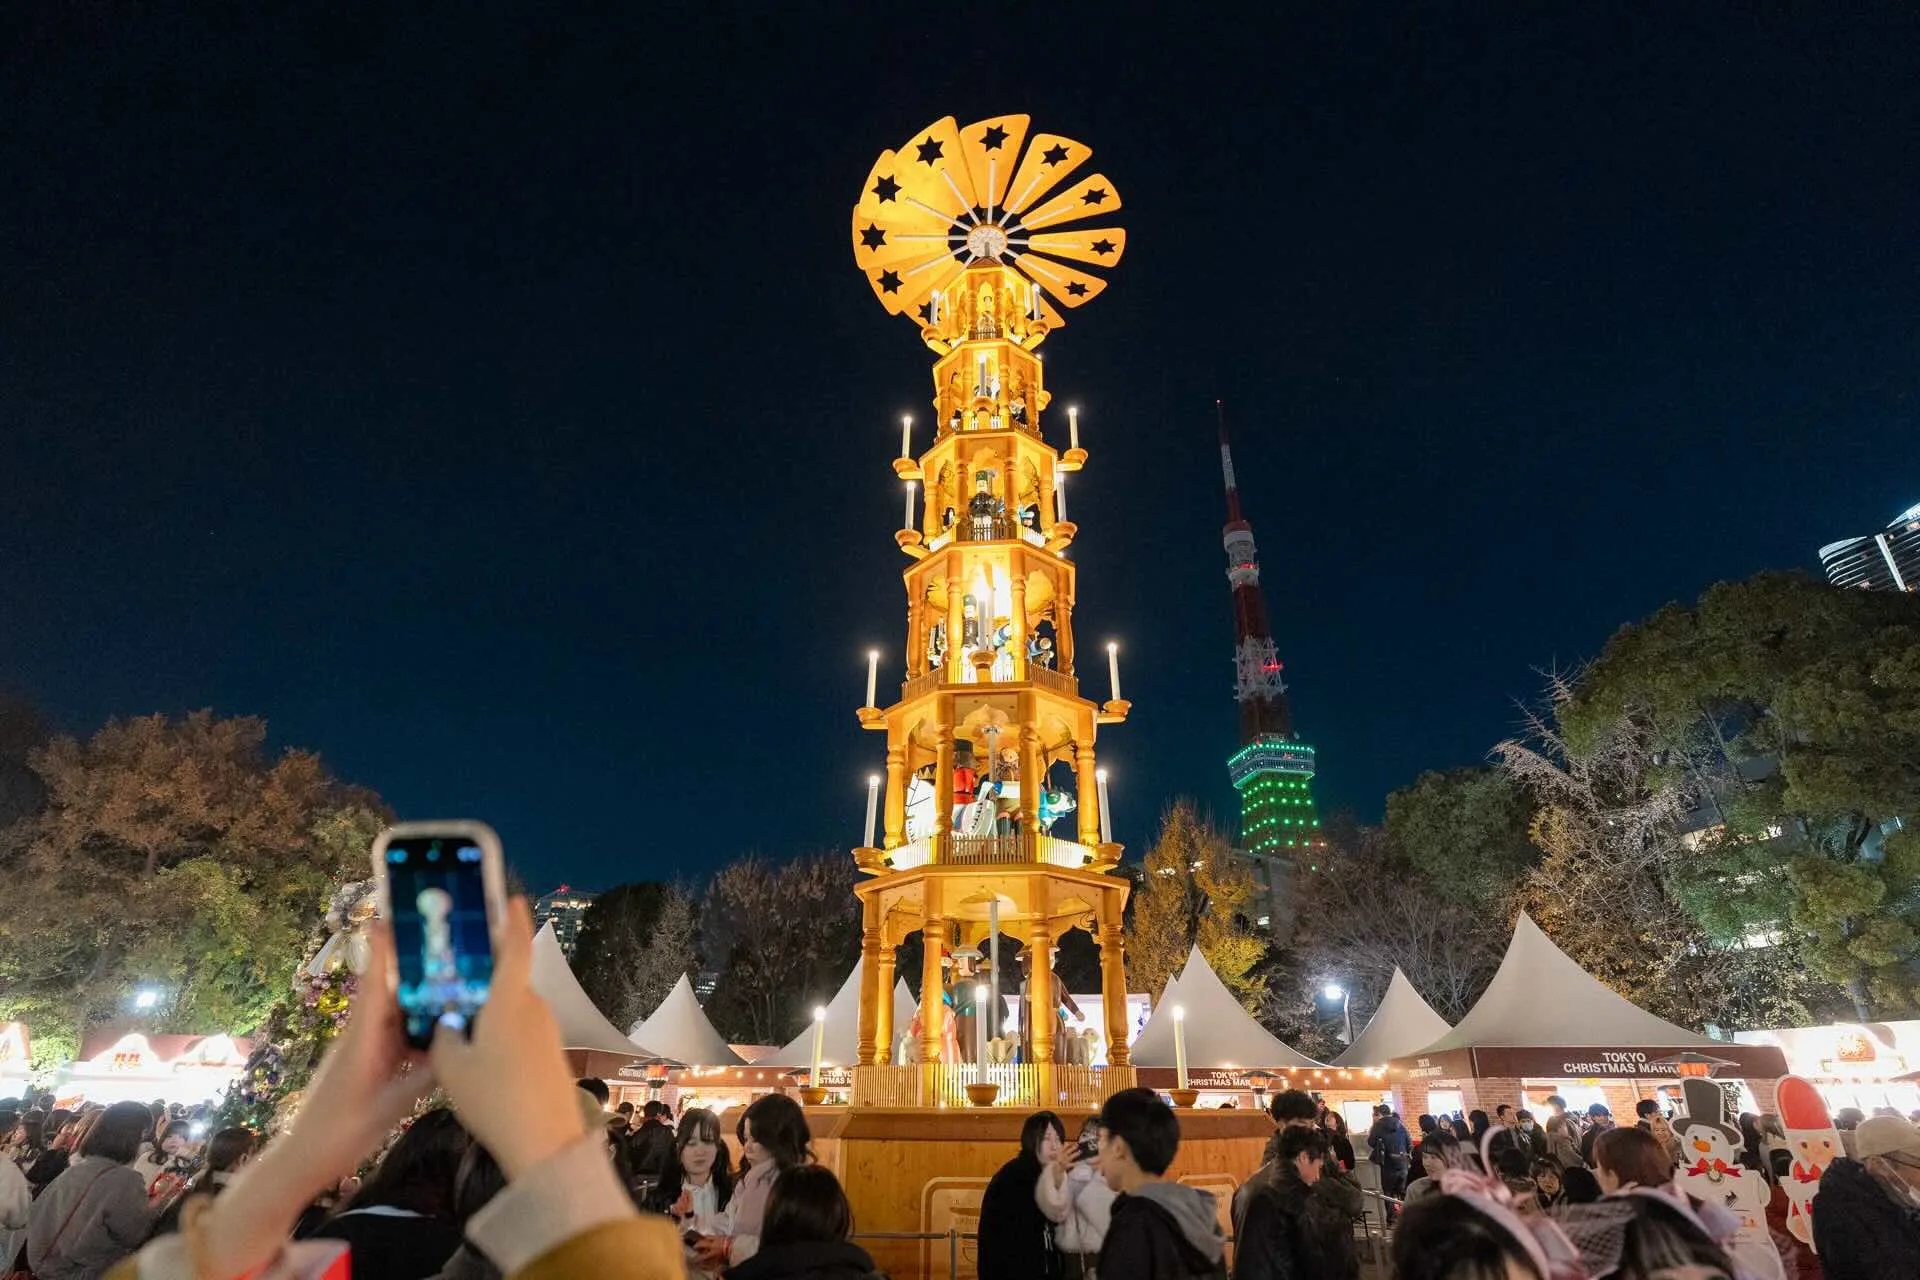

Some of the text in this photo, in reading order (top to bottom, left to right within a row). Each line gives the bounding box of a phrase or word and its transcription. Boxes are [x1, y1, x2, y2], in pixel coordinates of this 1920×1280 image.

[1602, 1052, 1646, 1063] TOKYO
[1563, 1063, 1680, 1073] CHRISTMAS MARK
[1211, 1071, 1239, 1080] TOKYO
[1187, 1078, 1251, 1086] CHRISTMAS MAR
